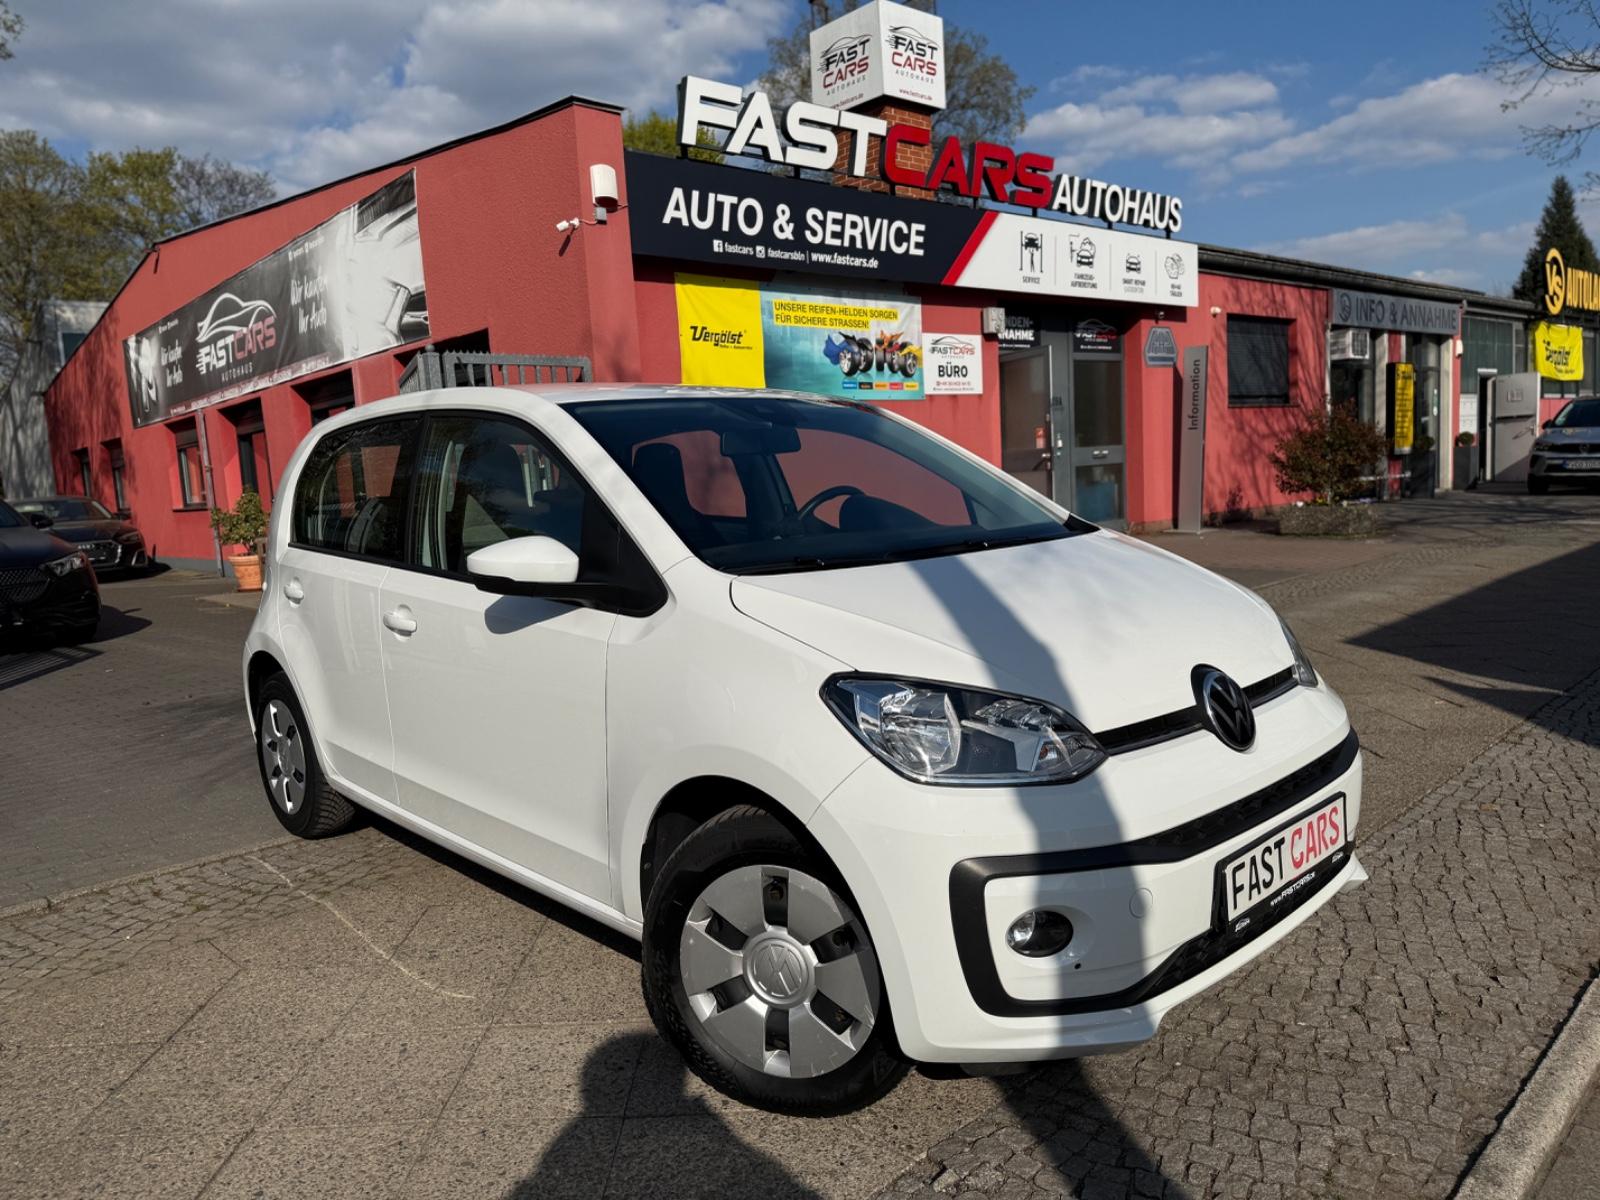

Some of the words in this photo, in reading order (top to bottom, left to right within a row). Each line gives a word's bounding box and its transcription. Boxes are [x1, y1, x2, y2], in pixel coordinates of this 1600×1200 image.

[825, 38, 870, 72] FAST
[893, 35, 938, 60] FAST
[823, 56, 869, 88] CARS
[891, 51, 937, 76] CARS
[827, 75, 866, 96] AUTOHAUS
[895, 69, 934, 84] AUTOHAUS
[1052, 173, 1183, 233] AUTOHAUS
[662, 187, 764, 236] AUTO
[773, 203, 795, 241] &
[804, 207, 926, 256] SERVICE
[724, 241, 754, 255] fastcars
[811, 251, 879, 269] www.fastcars.de
[774, 302, 807, 313] UNSERE
[809, 304, 868, 318] REIFEN-HELDEN
[869, 309, 898, 320] SORGEN
[775, 313, 792, 323] FÜR
[793, 315, 828, 326] SICHERE
[829, 317, 869, 329] STRASSEN!
[1356, 296, 1385, 323] INFO
[1390, 302, 1398, 324] &
[1400, 304, 1457, 330] ANNAHME
[690, 325, 743, 346] Vergölst
[222, 362, 253, 382] AUTOHAUS
[938, 361, 968, 378] BÜRO
[1188, 359, 1201, 431] Information
[1232, 837, 1286, 910] FAST
[1290, 806, 1340, 869] CARS
